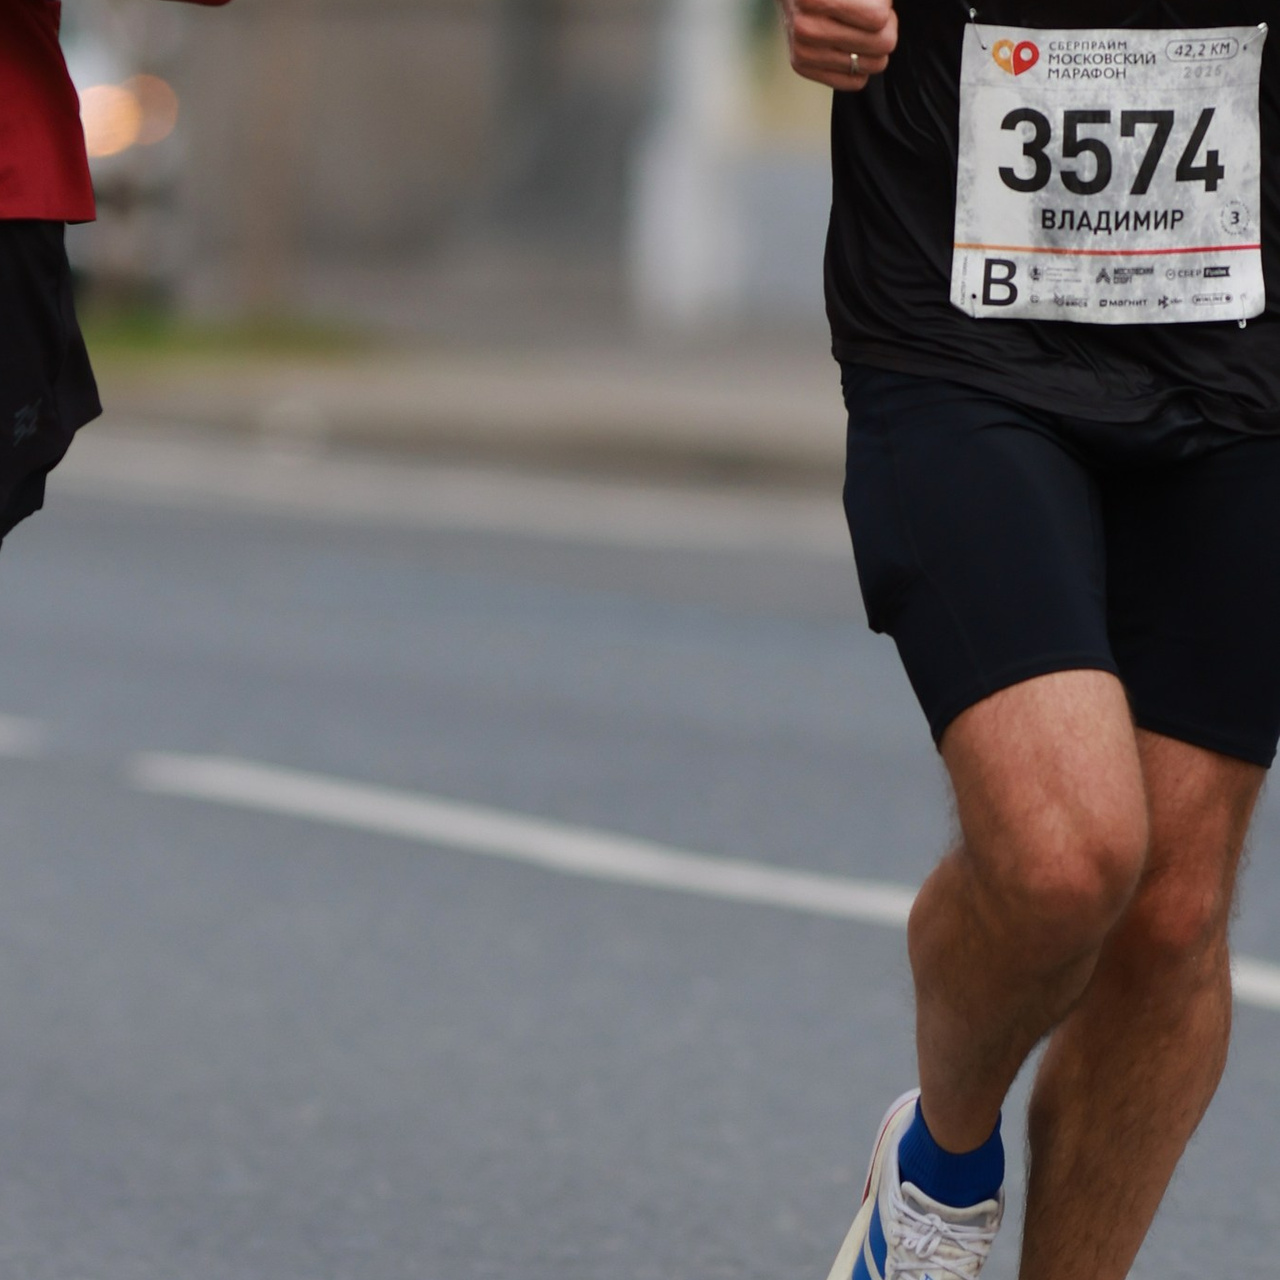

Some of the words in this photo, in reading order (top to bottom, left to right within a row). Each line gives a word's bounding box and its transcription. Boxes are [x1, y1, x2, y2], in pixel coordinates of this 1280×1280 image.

[1048, 39, 1128, 51] СБЕРПРАЙМ
[1174, 42, 1206, 58] 42,2
[1048, 51, 1157, 66] МОСКОВСКИЙ
[1047, 67, 1127, 80] МАРАФОН
[998, 106, 1225, 196] 3574
[1041, 209, 1184, 234] ВЛАДИМИР
[1230, 210, 1240, 225] 3
